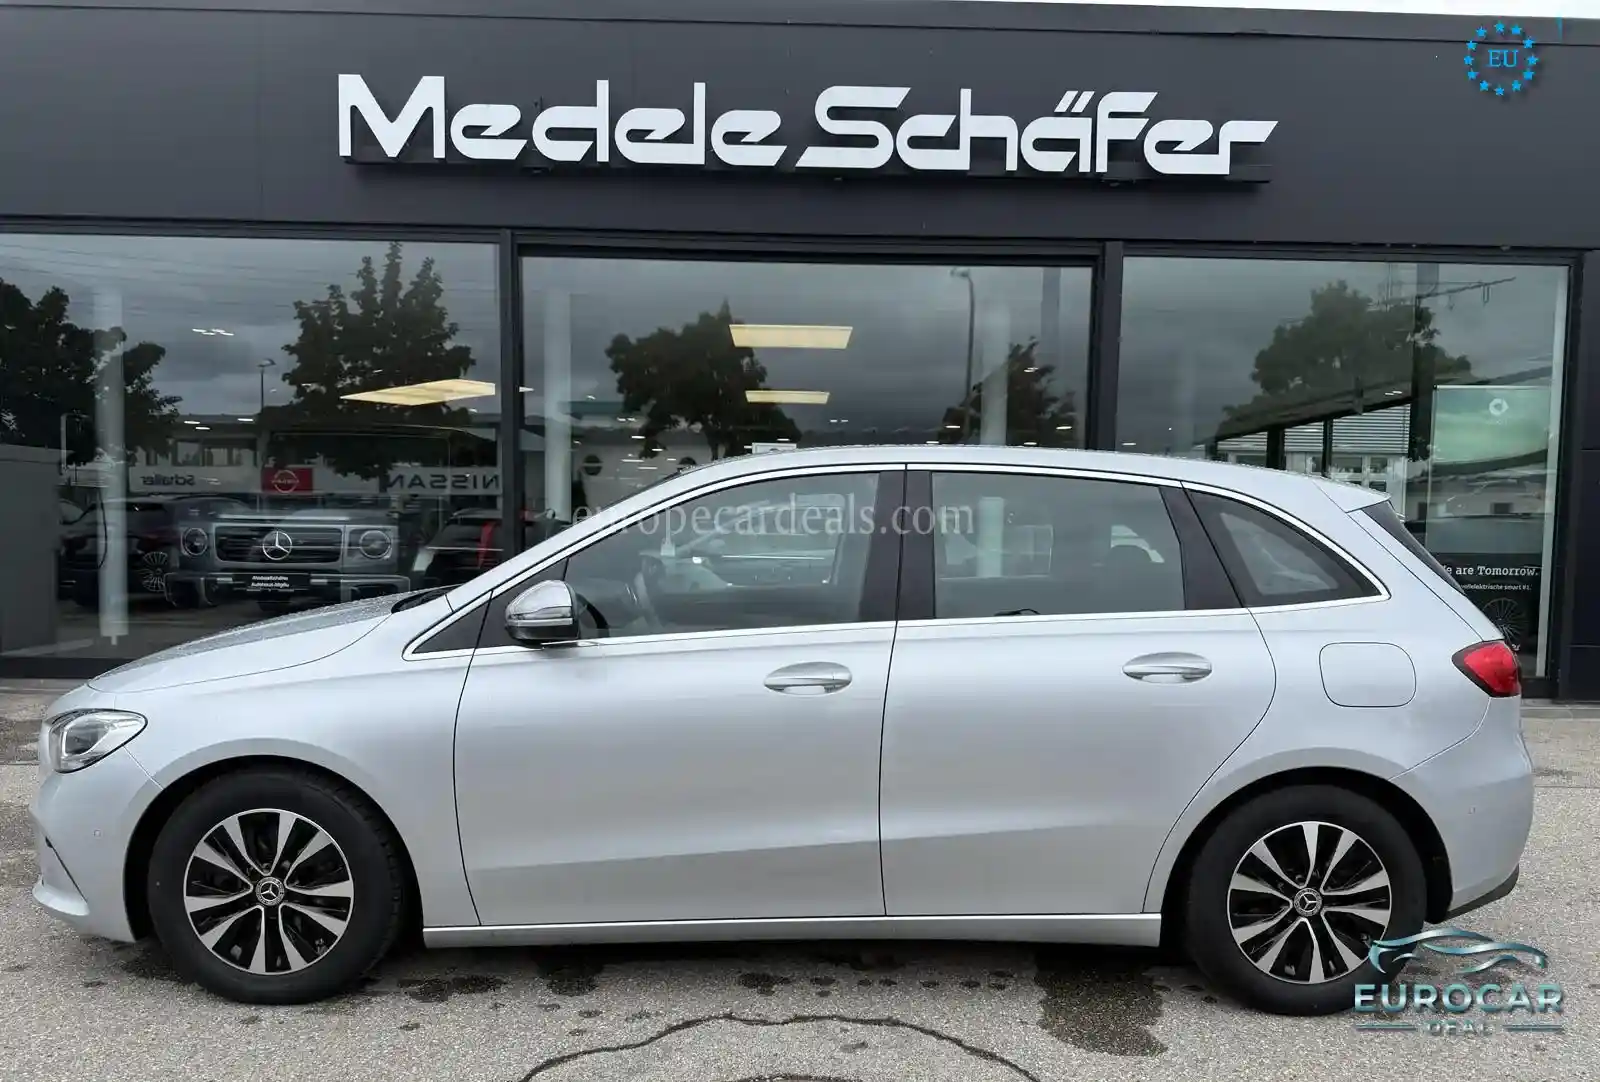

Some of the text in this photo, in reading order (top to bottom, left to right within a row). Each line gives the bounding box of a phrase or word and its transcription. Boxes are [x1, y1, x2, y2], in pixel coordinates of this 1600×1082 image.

[338, 74, 1279, 175] Medele Schäfer
[1455, 566, 1474, 576] are
[1477, 565, 1539, 576] Tomorrow.
